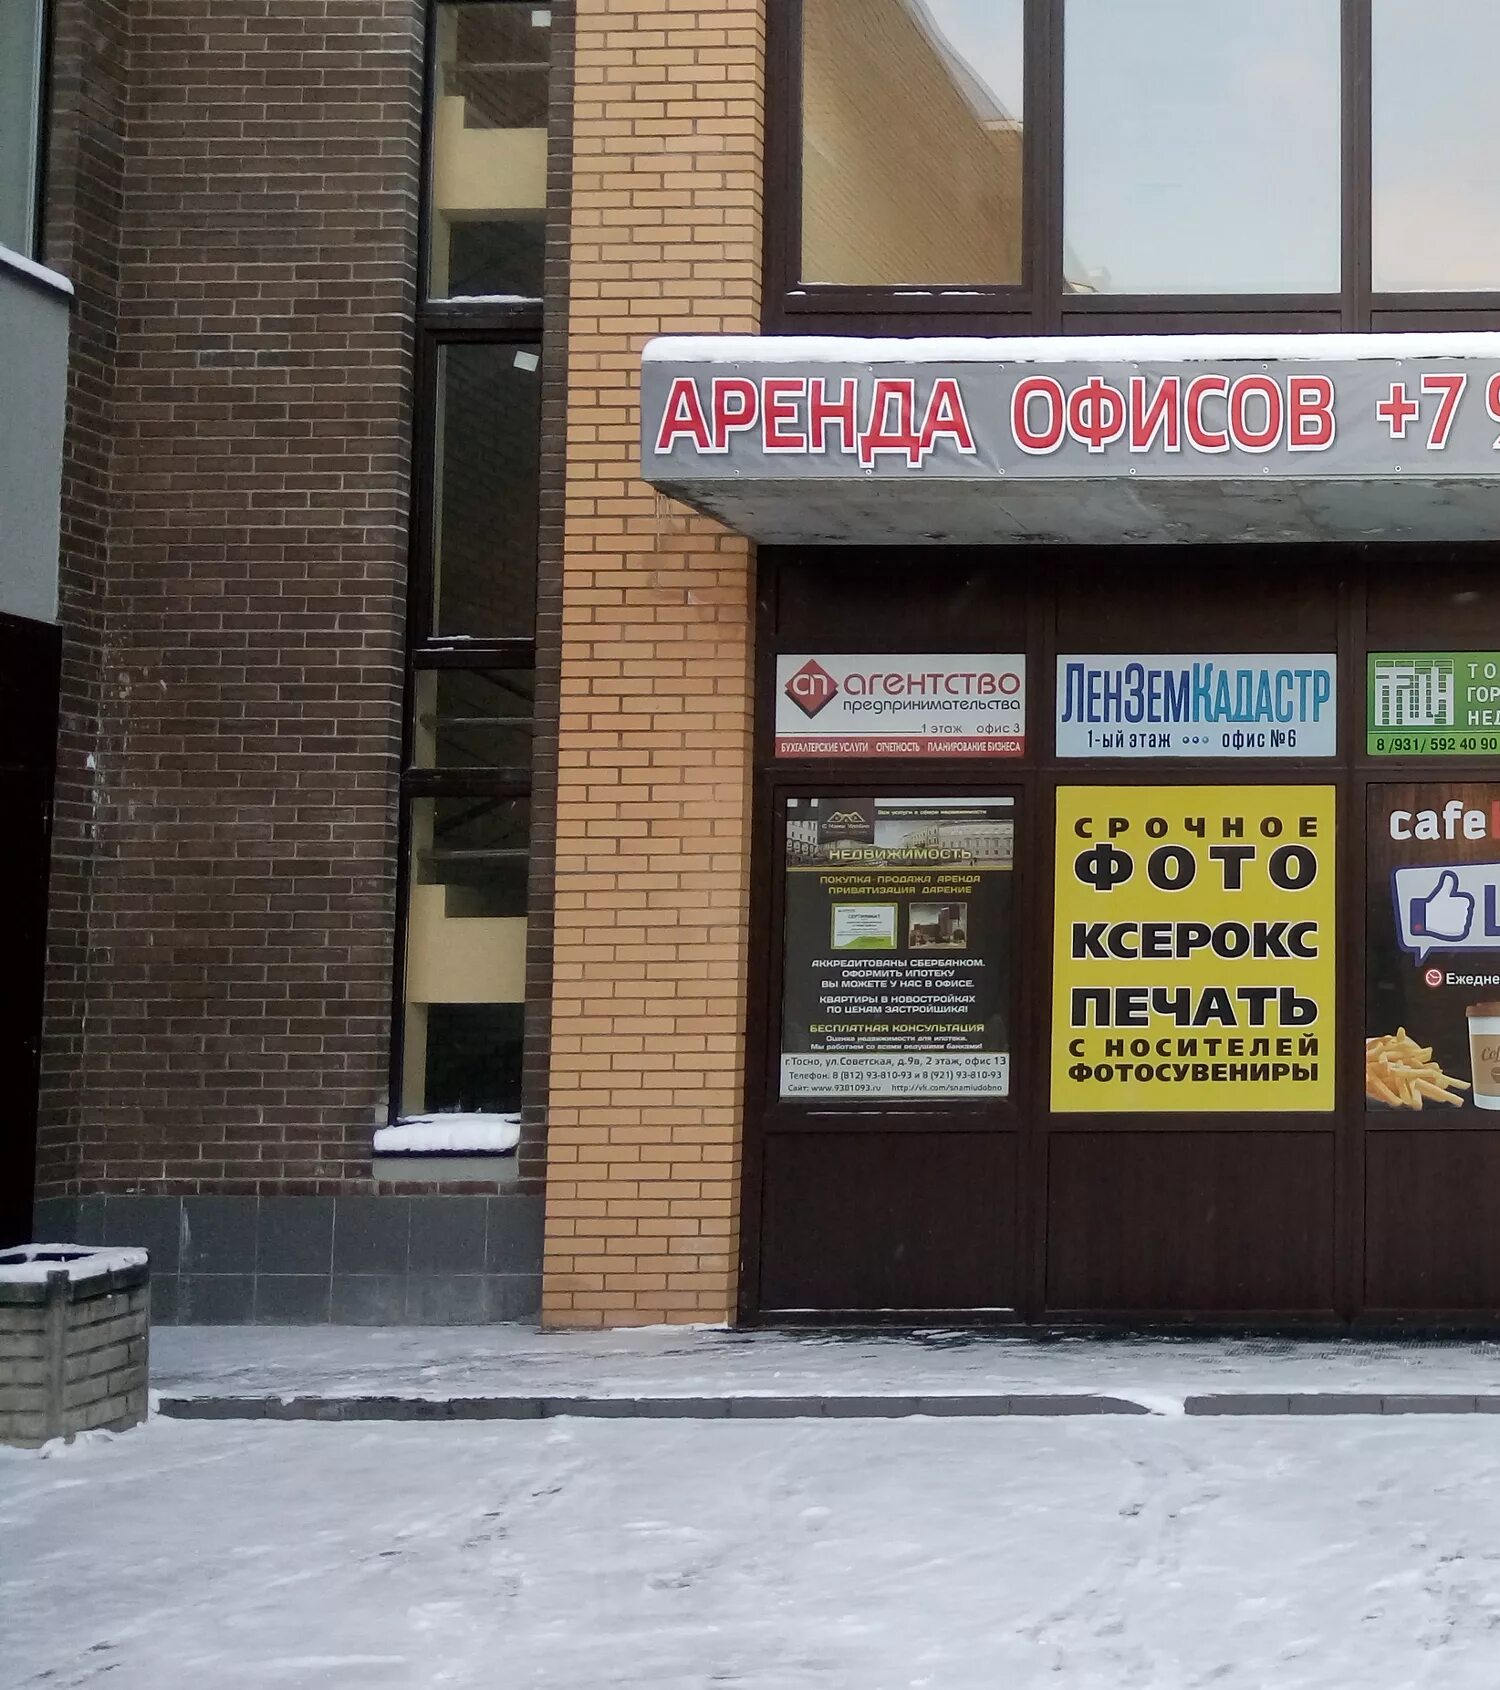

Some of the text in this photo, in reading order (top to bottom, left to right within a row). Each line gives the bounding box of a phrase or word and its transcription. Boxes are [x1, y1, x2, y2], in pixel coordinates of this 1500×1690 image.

[655, 376, 976, 467] АРЕНДА
[1011, 376, 1335, 454] ОФИСОВ
[1376, 373, 1468, 450] +7
[844, 700, 1020, 714] предпринимательства
[922, 723, 1020, 735] 1 этаж офис 3
[1088, 730, 1124, 748] 1-ый
[1130, 733, 1171, 748] этаж
[1222, 730, 1265, 750] офис
[1377, 738, 1384, 750] 8
[1430, 738, 1455, 750] 592
[1460, 738, 1476, 750] 40
[1481, 738, 1497, 750] 90
[780, 742, 1020, 753] БУХГАЛТЕРСКИЕ УСЛУГИ ОТЧЕТНОСТЬ ПЛАНИРОВАНИЕ БИЗНЕСА
[1074, 816, 1318, 839] СРОЧНОЕ
[829, 849, 972, 860] НЕДВИЖИМОСТЬ
[1073, 842, 1318, 892] ФОТО
[820, 876, 871, 884] ПОКУПКА
[937, 875, 981, 883] АРЕНДА
[922, 886, 972, 894] ДАРЕНИЕ
[1071, 921, 1319, 960] КСЕРОКС
[812, 959, 985, 967] АККРЕДИТОВАНЫ СБЕРБАНКОМ.
[905, 969, 955, 977] ИПОТЕКУ
[822, 980, 838, 988] ВЫ
[841, 980, 887, 988] МОЖЕТЕ
[890, 980, 897, 988] У
[820, 996, 878, 1004] КВАРТИРЫ
[891, 994, 975, 1003] НОВОСТРОЙКАХ
[827, 1004, 968, 1014] ПО ЦЕНАМ ЗАСТРОЙЩИКА!
[1070, 986, 1320, 1028] ПЕЧАТЬ
[810, 1024, 984, 1033] БЕСПЛАТНАЯ КОНСУЛЬТАЦИЯ
[1069, 1033, 1318, 1057] С НОСИТЕЛЕЙ
[926, 1057, 932, 1065] 2
[965, 1057, 991, 1067] офис
[995, 1056, 1006, 1065] 13
[832, 1071, 838, 1079] 8
[841, 1071, 864, 1080] (812)
[866, 1071, 912, 1079] 93-810-93
[922, 1071, 928, 1079] 8
[931, 1071, 953, 1080] (921)
[956, 1071, 1002, 1079] 93-810-93
[1068, 1063, 1318, 1082] ФОТОСУВЕНИРЫ
[892, 1084, 1002, 1092] http://vk.com/snamiudobno
